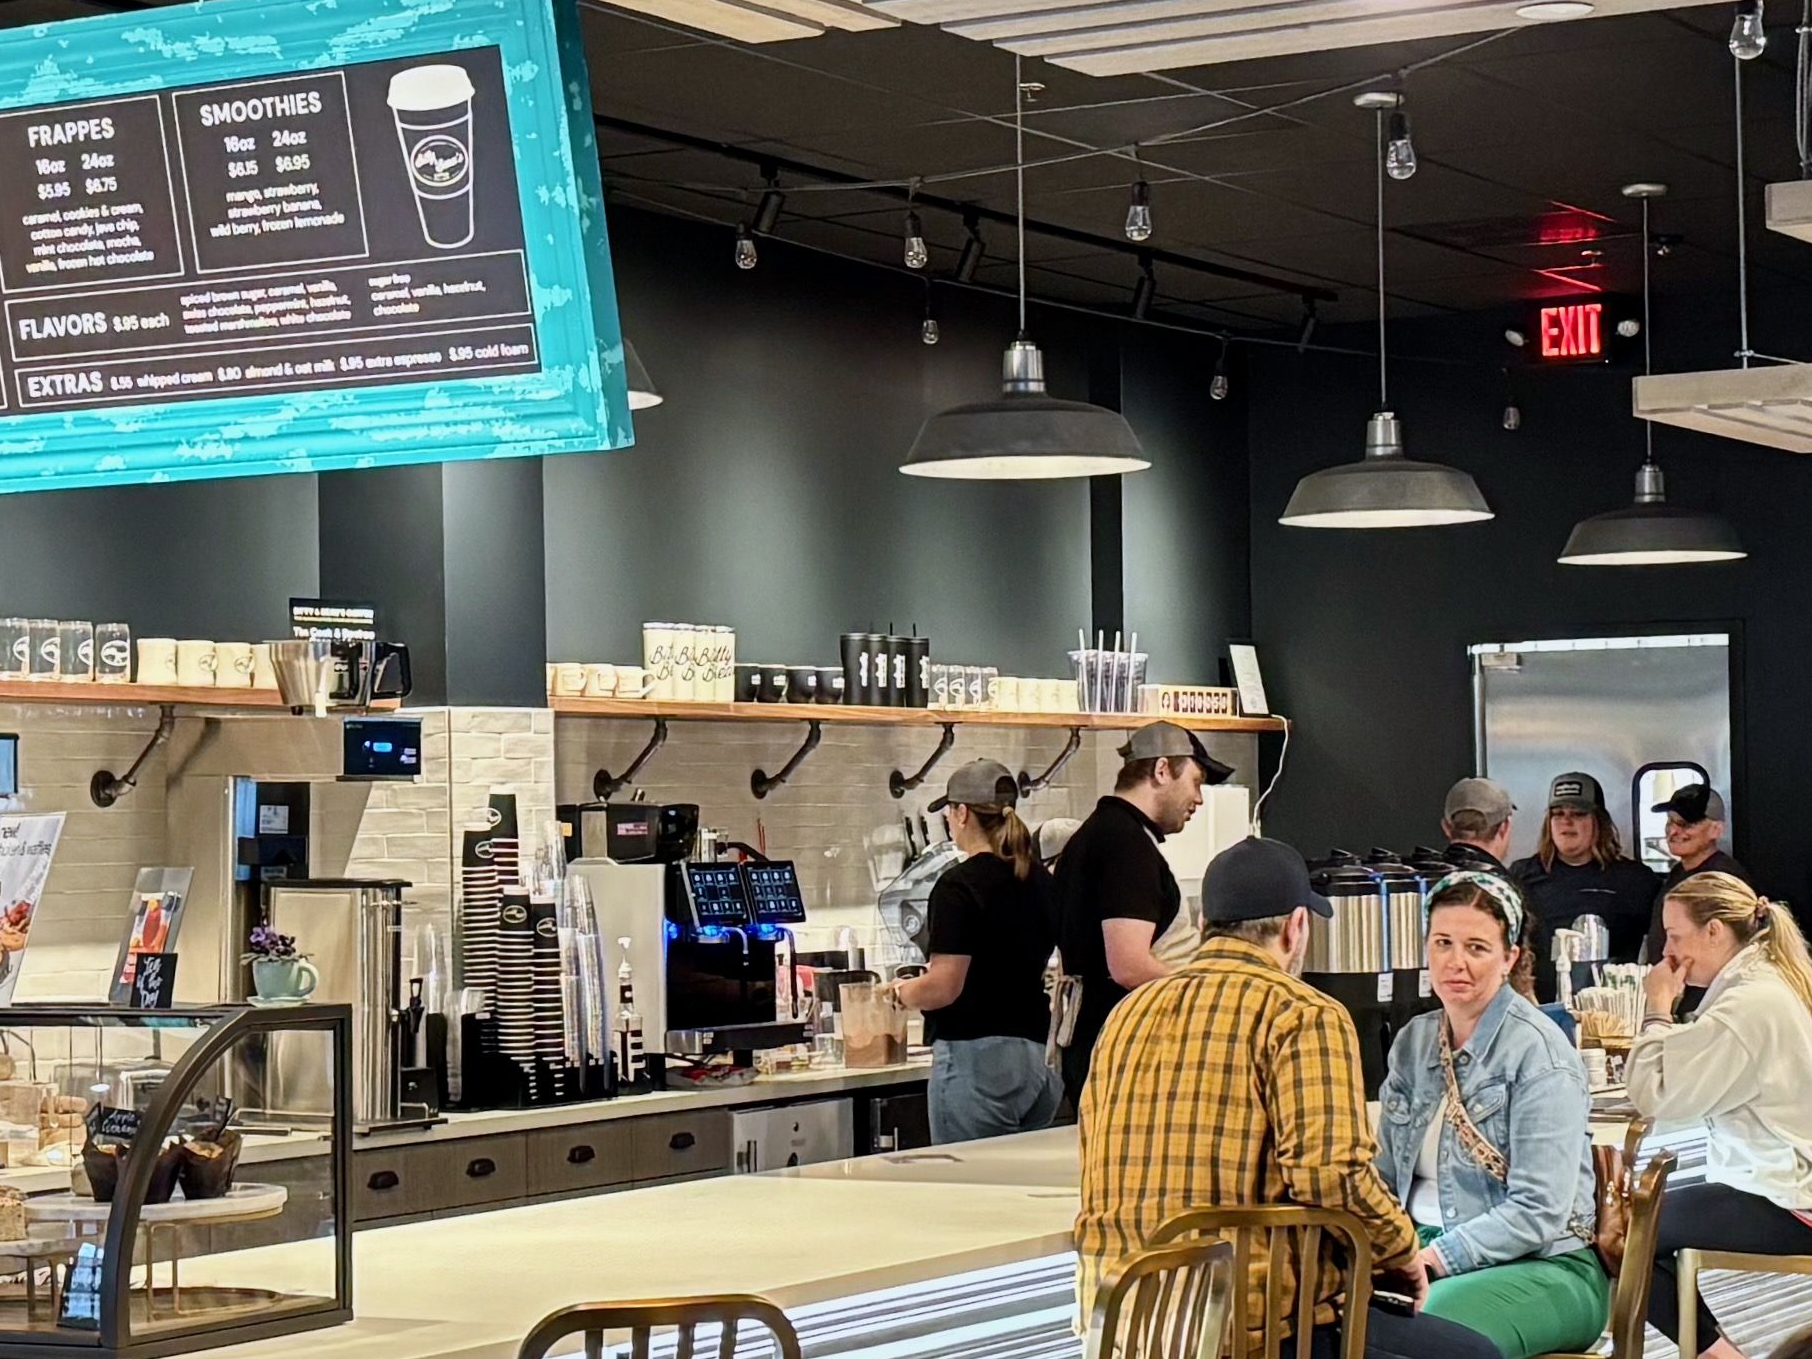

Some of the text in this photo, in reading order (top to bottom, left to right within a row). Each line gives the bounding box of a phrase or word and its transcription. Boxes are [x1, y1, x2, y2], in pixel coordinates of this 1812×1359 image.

[199, 90, 322, 127] SMOOTHIES
[27, 116, 115, 147] FRAPPES
[223, 127, 307, 153] 16oz 24oz
[35, 150, 115, 175] 16oz 24oz
[227, 152, 311, 178] $6.15 $6.95
[225, 180, 319, 205] mango, strawberry,
[62, 205, 100, 221] cookies
[99, 204, 109, 217] &
[110, 202, 143, 216] cream,
[227, 196, 322, 221] strawberry banana,
[29, 217, 140, 241] cotton candy, java chip,
[209, 210, 345, 237] wild berry, frozen lemonade
[32, 242, 56, 256] mint
[55, 237, 105, 255] chocolate,
[87, 253, 105, 267] hot
[105, 248, 154, 265] chocolate
[18, 311, 108, 341] FLAVORS
[138, 311, 170, 329] each
[1540, 303, 1603, 358] EXIT
[26, 371, 104, 398] EXTRAS
[136, 371, 181, 390] whipped
[180, 371, 213, 384] cream
[244, 362, 284, 379] almond
[283, 362, 294, 375] &
[293, 361, 313, 374] oat
[312, 358, 335, 372] milk
[364, 355, 393, 368] extra
[393, 351, 443, 368] espresso
[448, 345, 474, 361] $.95
[473, 344, 499, 359] cold
[499, 341, 529, 356] foam
